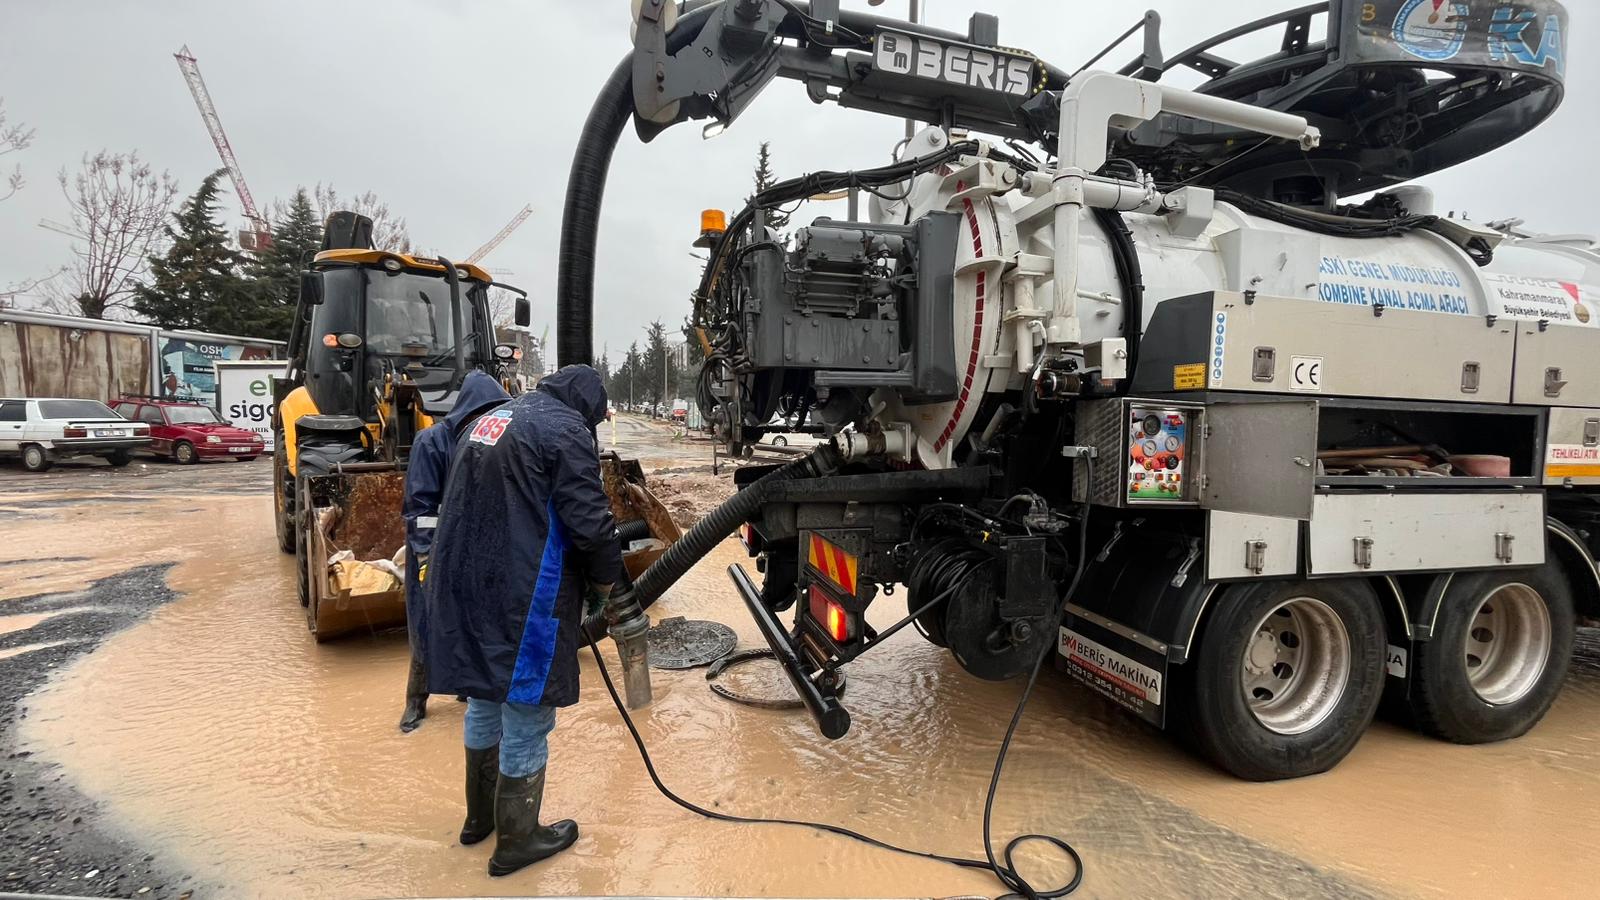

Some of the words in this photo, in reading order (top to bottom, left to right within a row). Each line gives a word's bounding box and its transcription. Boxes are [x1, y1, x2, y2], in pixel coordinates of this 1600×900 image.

[1348, 260, 1389, 280] GENEL
[1369, 287, 1406, 308] KANAL
[1078, 643, 1105, 667] BERİŞ
[1108, 658, 1159, 692] MAKİNA
